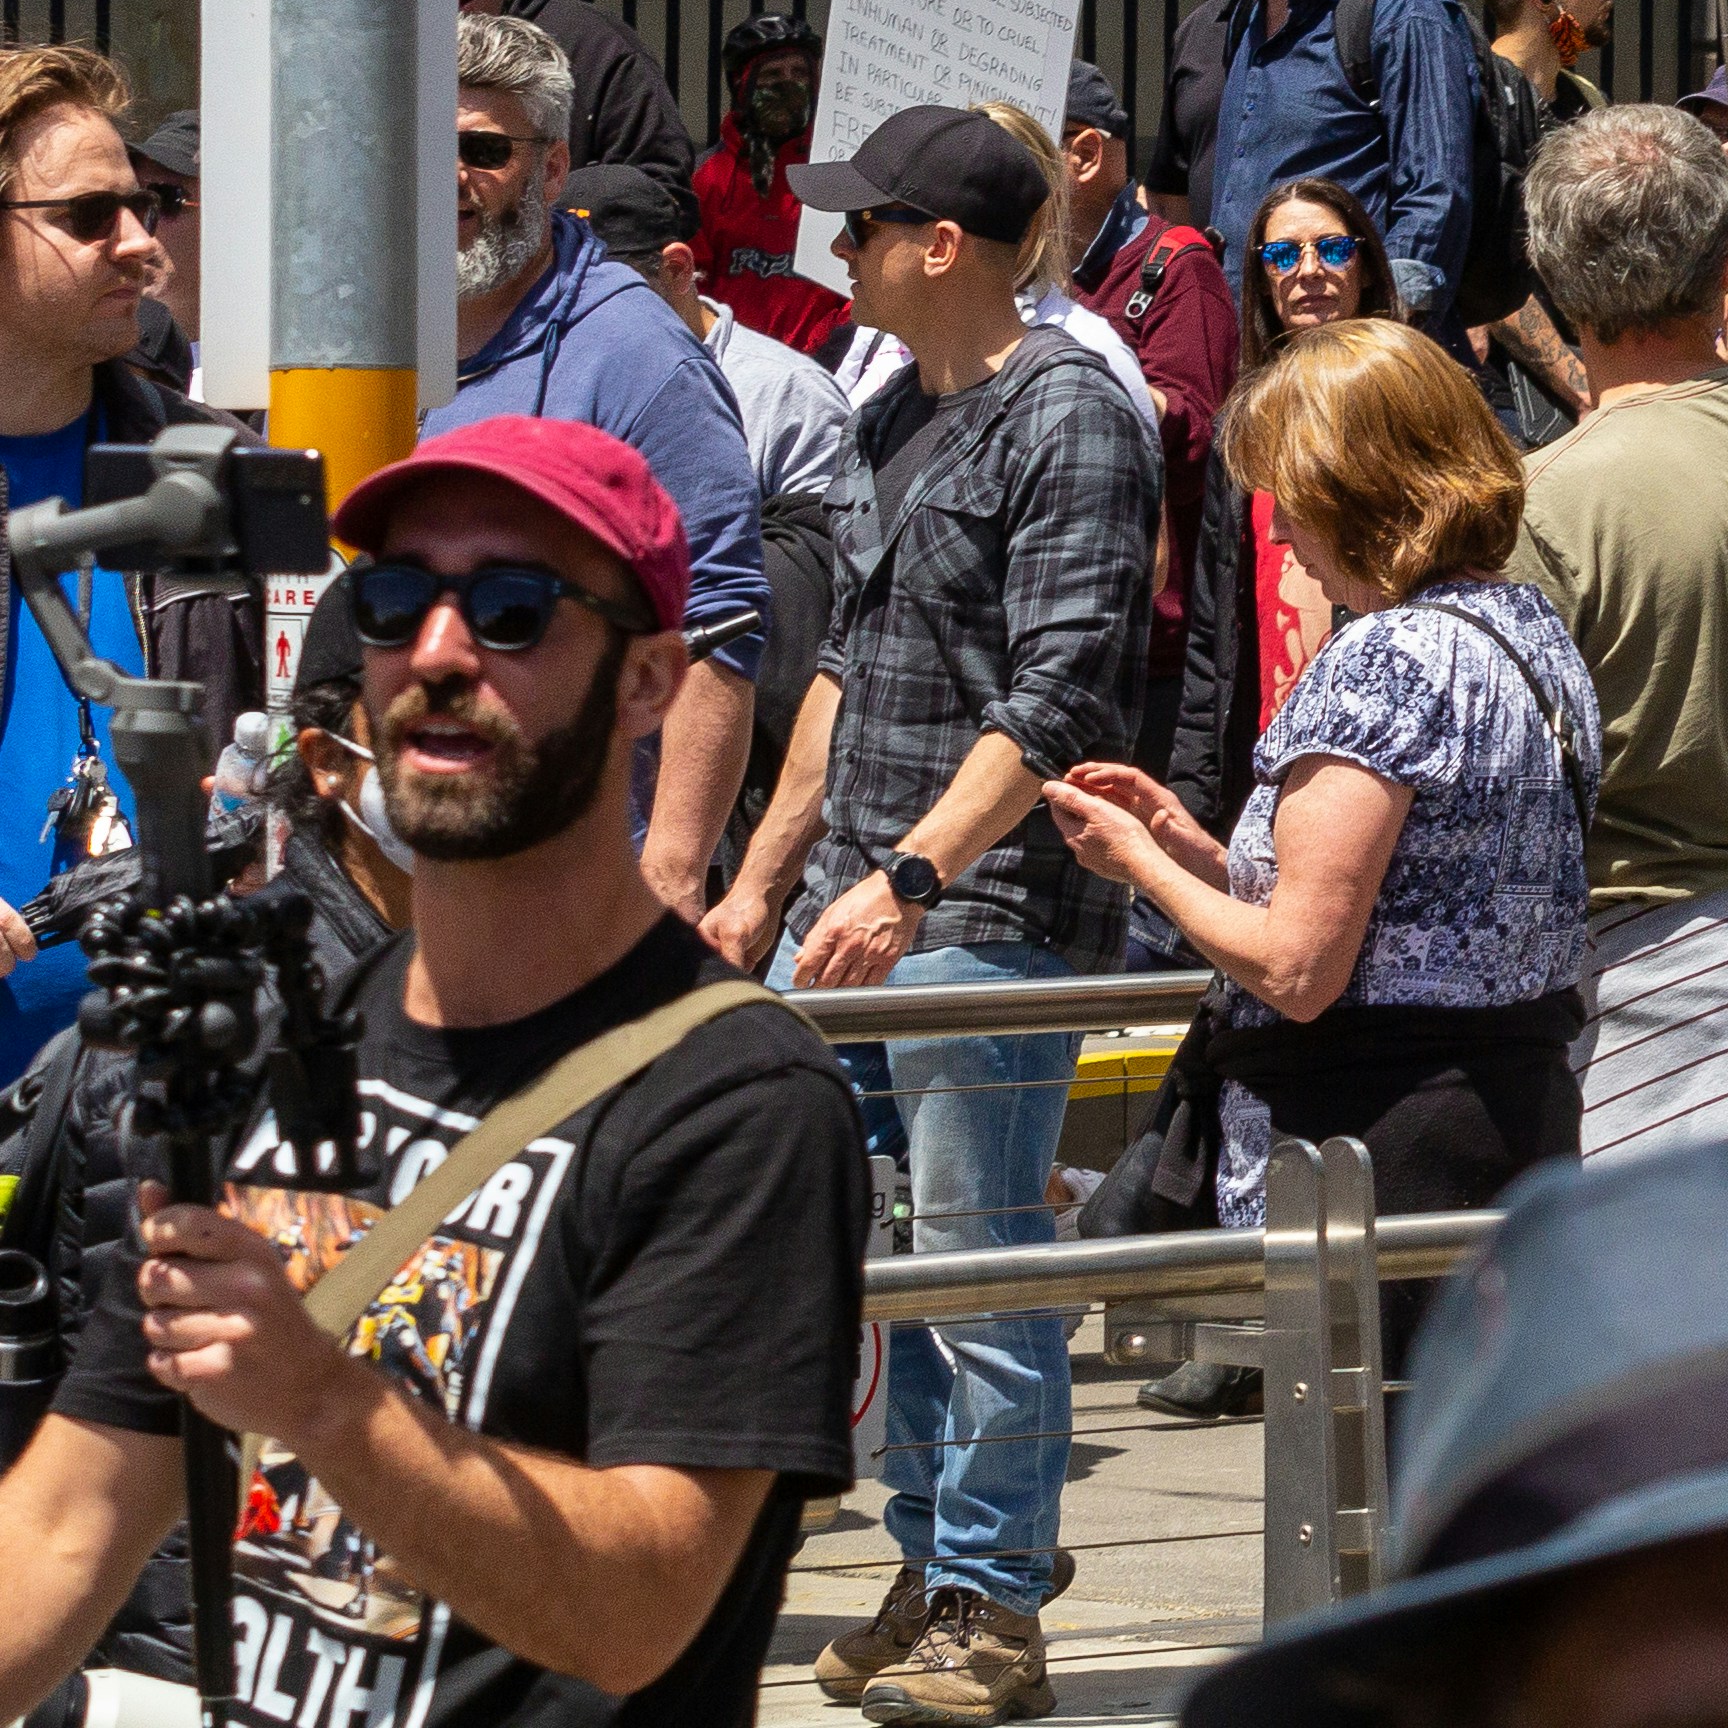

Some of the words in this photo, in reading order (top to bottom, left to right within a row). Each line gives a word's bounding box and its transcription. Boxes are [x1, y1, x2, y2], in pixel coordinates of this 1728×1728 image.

[977, 14, 994, 36] TO
[841, 20, 930, 72] TREATMENT
[837, 50, 859, 76] IN
[958, 42, 1044, 92] DEGRADING
[834, 81, 853, 104] BE
[267, 589, 316, 606] ARE
